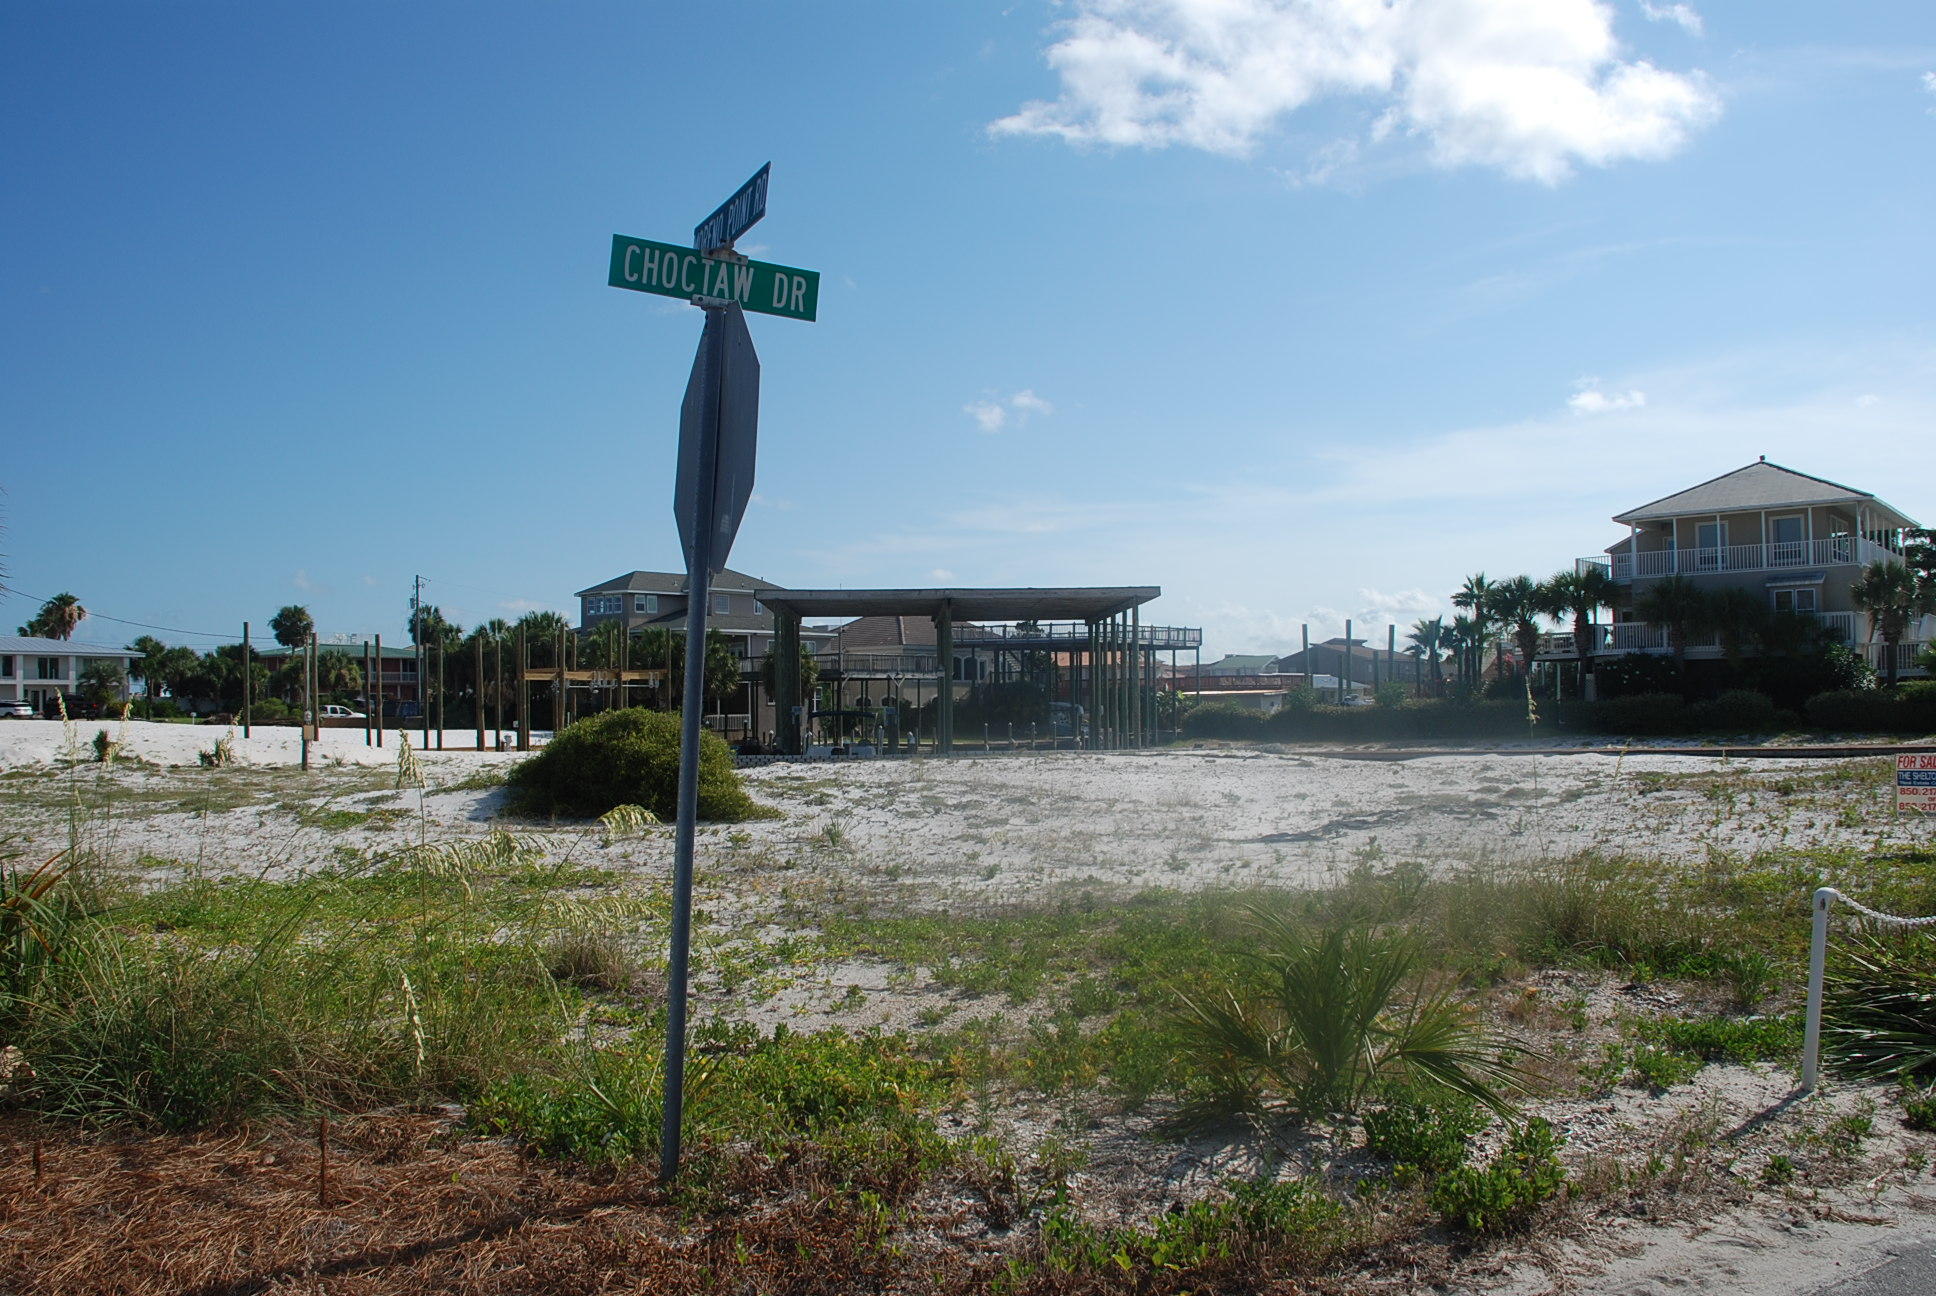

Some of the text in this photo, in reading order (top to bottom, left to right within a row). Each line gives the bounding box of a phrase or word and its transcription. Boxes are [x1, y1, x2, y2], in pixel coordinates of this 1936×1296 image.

[727, 187, 753, 238] POINT
[753, 173, 767, 216] RD
[624, 245, 806, 313] CHOCTAW DR
[1897, 756, 1917, 768] FOR
[1899, 772, 1911, 780] THE
[1898, 802, 1936, 811] 8217
